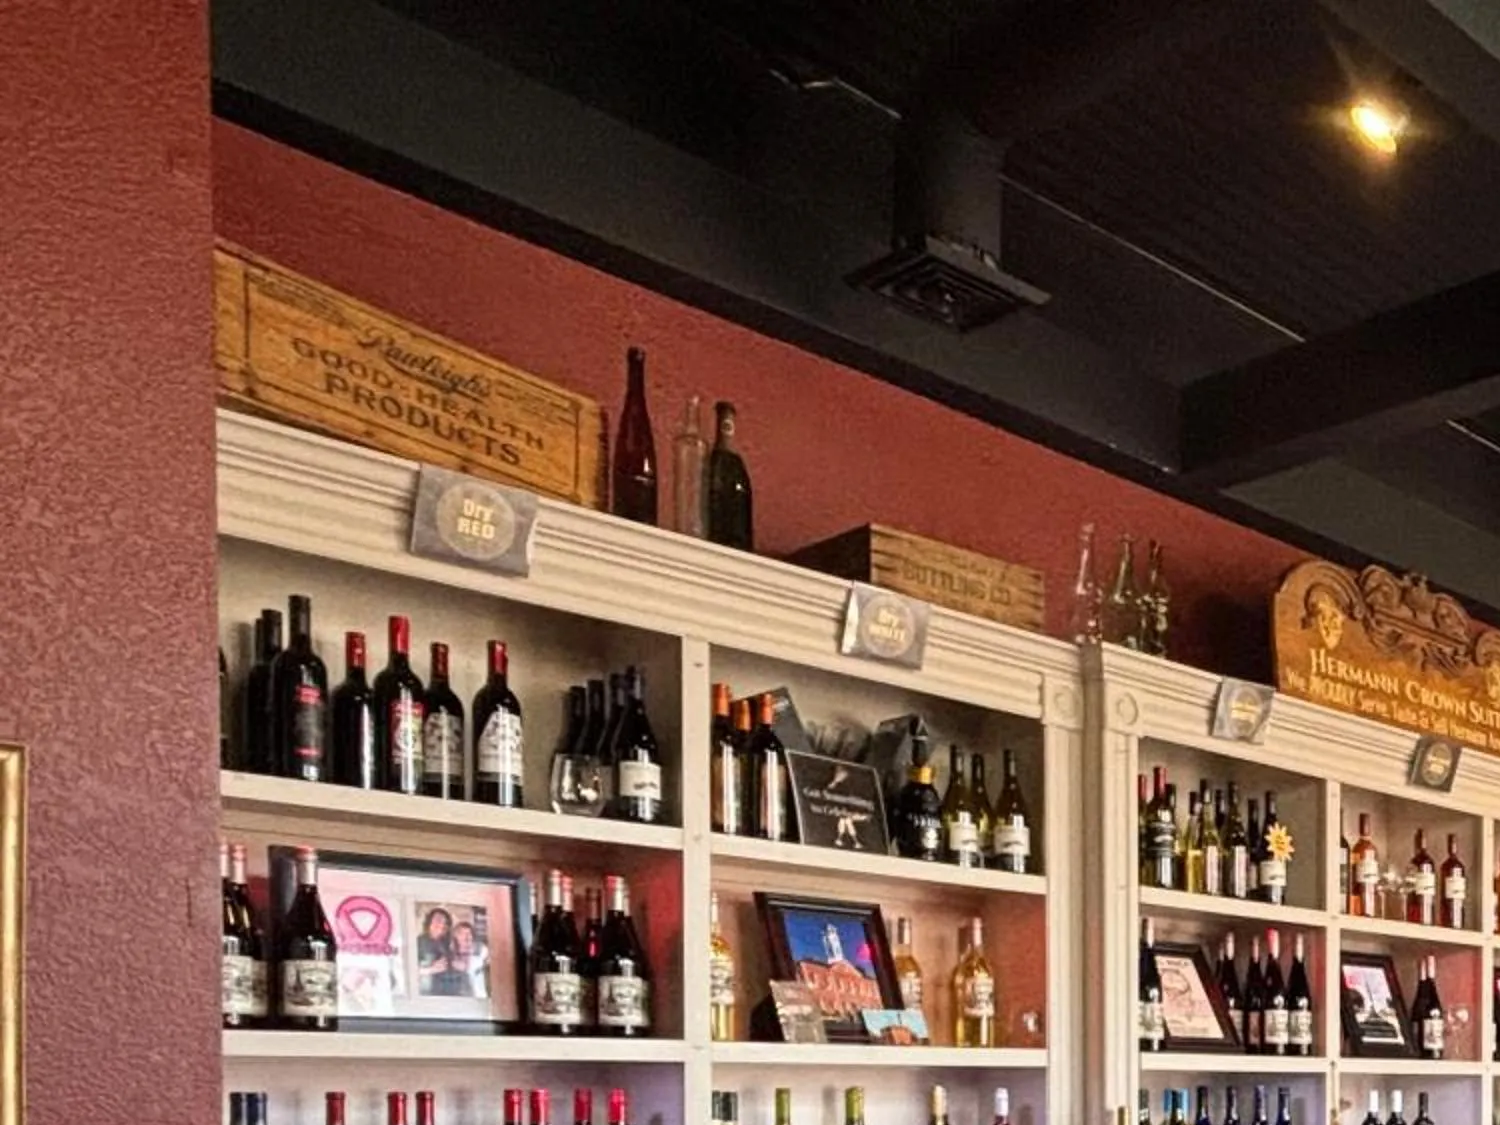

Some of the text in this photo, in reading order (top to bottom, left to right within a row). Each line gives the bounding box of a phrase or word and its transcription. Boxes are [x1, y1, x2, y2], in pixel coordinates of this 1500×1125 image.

[324, 375, 521, 467] PRODUCTS
[1309, 648, 1400, 696] HERMANN
[1404, 680, 1468, 718] CROWN
